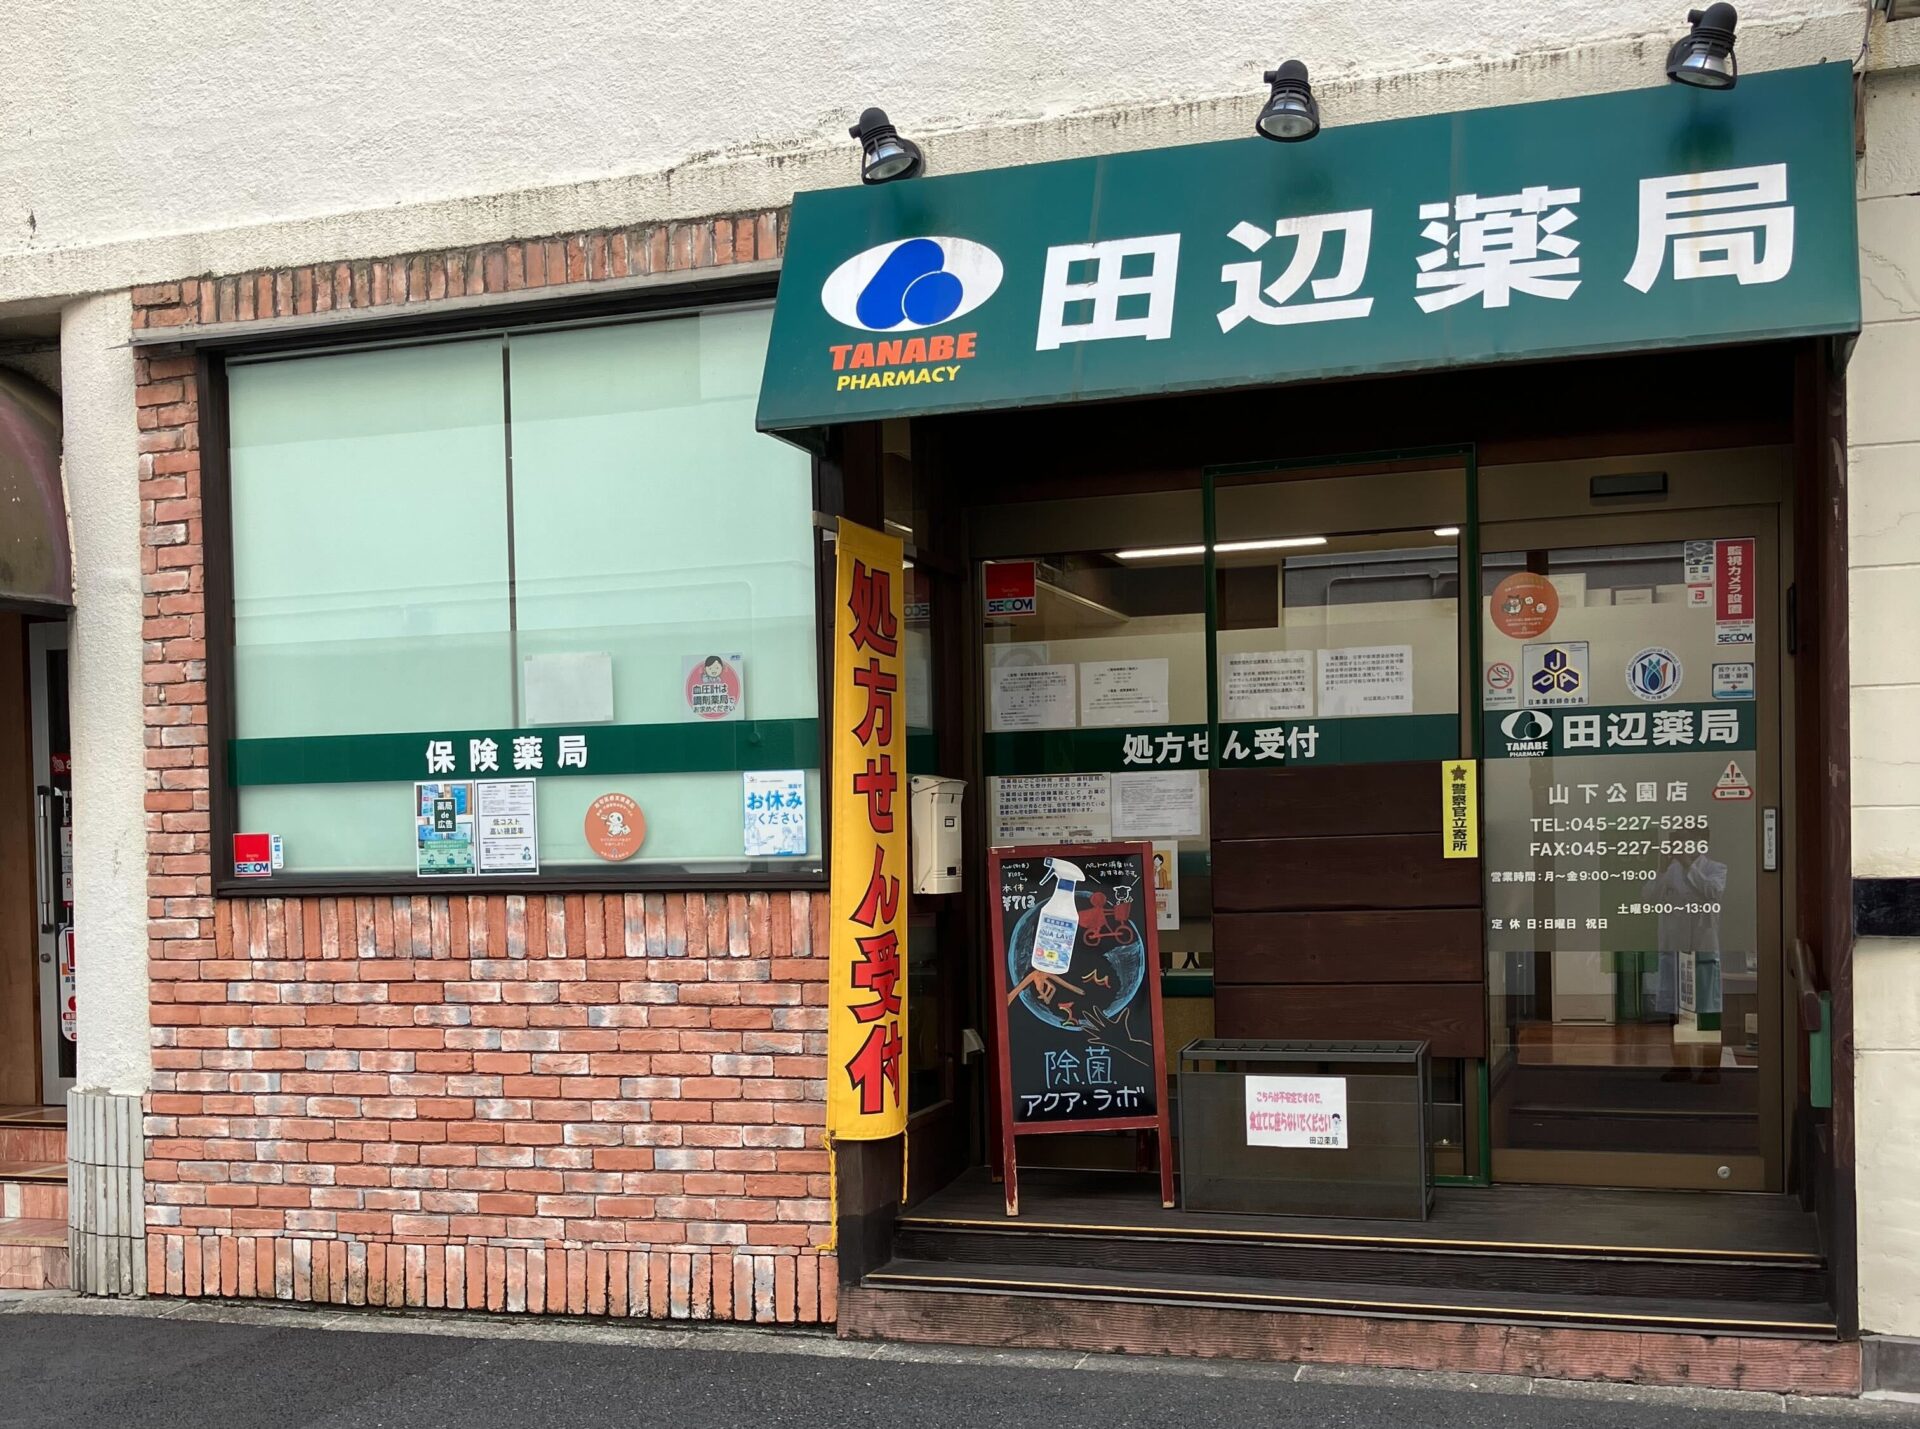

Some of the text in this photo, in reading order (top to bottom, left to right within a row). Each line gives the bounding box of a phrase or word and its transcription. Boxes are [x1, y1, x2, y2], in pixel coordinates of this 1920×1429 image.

[1036, 162, 1794, 352] 田辺薬局
[830, 331, 978, 371] TANABE
[835, 363, 962, 392] PHARMACY
[988, 599, 1033, 612] SECOM
[1718, 633, 1753, 643] SECOM
[1562, 708, 1739, 749] 田辺薬局
[425, 735, 589, 773] 保険薬局
[1122, 725, 1319, 765] 処方せん受付
[1505, 741, 1548, 752] TANABE
[746, 790, 803, 811] お休み
[1548, 781, 1689, 805] 山下公園店
[440, 811, 450, 819] de
[758, 811, 804, 825] ください
[1451, 783, 1468, 852] 警察官立寄所
[1529, 814, 1709, 833] TEL:045-227-5285
[846, 557, 904, 1116] 処方せん受付
[1529, 839, 1710, 857] FAX:045-227-5286
[236, 862, 269, 873] SECOM
[1309, 1136, 1339, 1145] 田辺薬局
